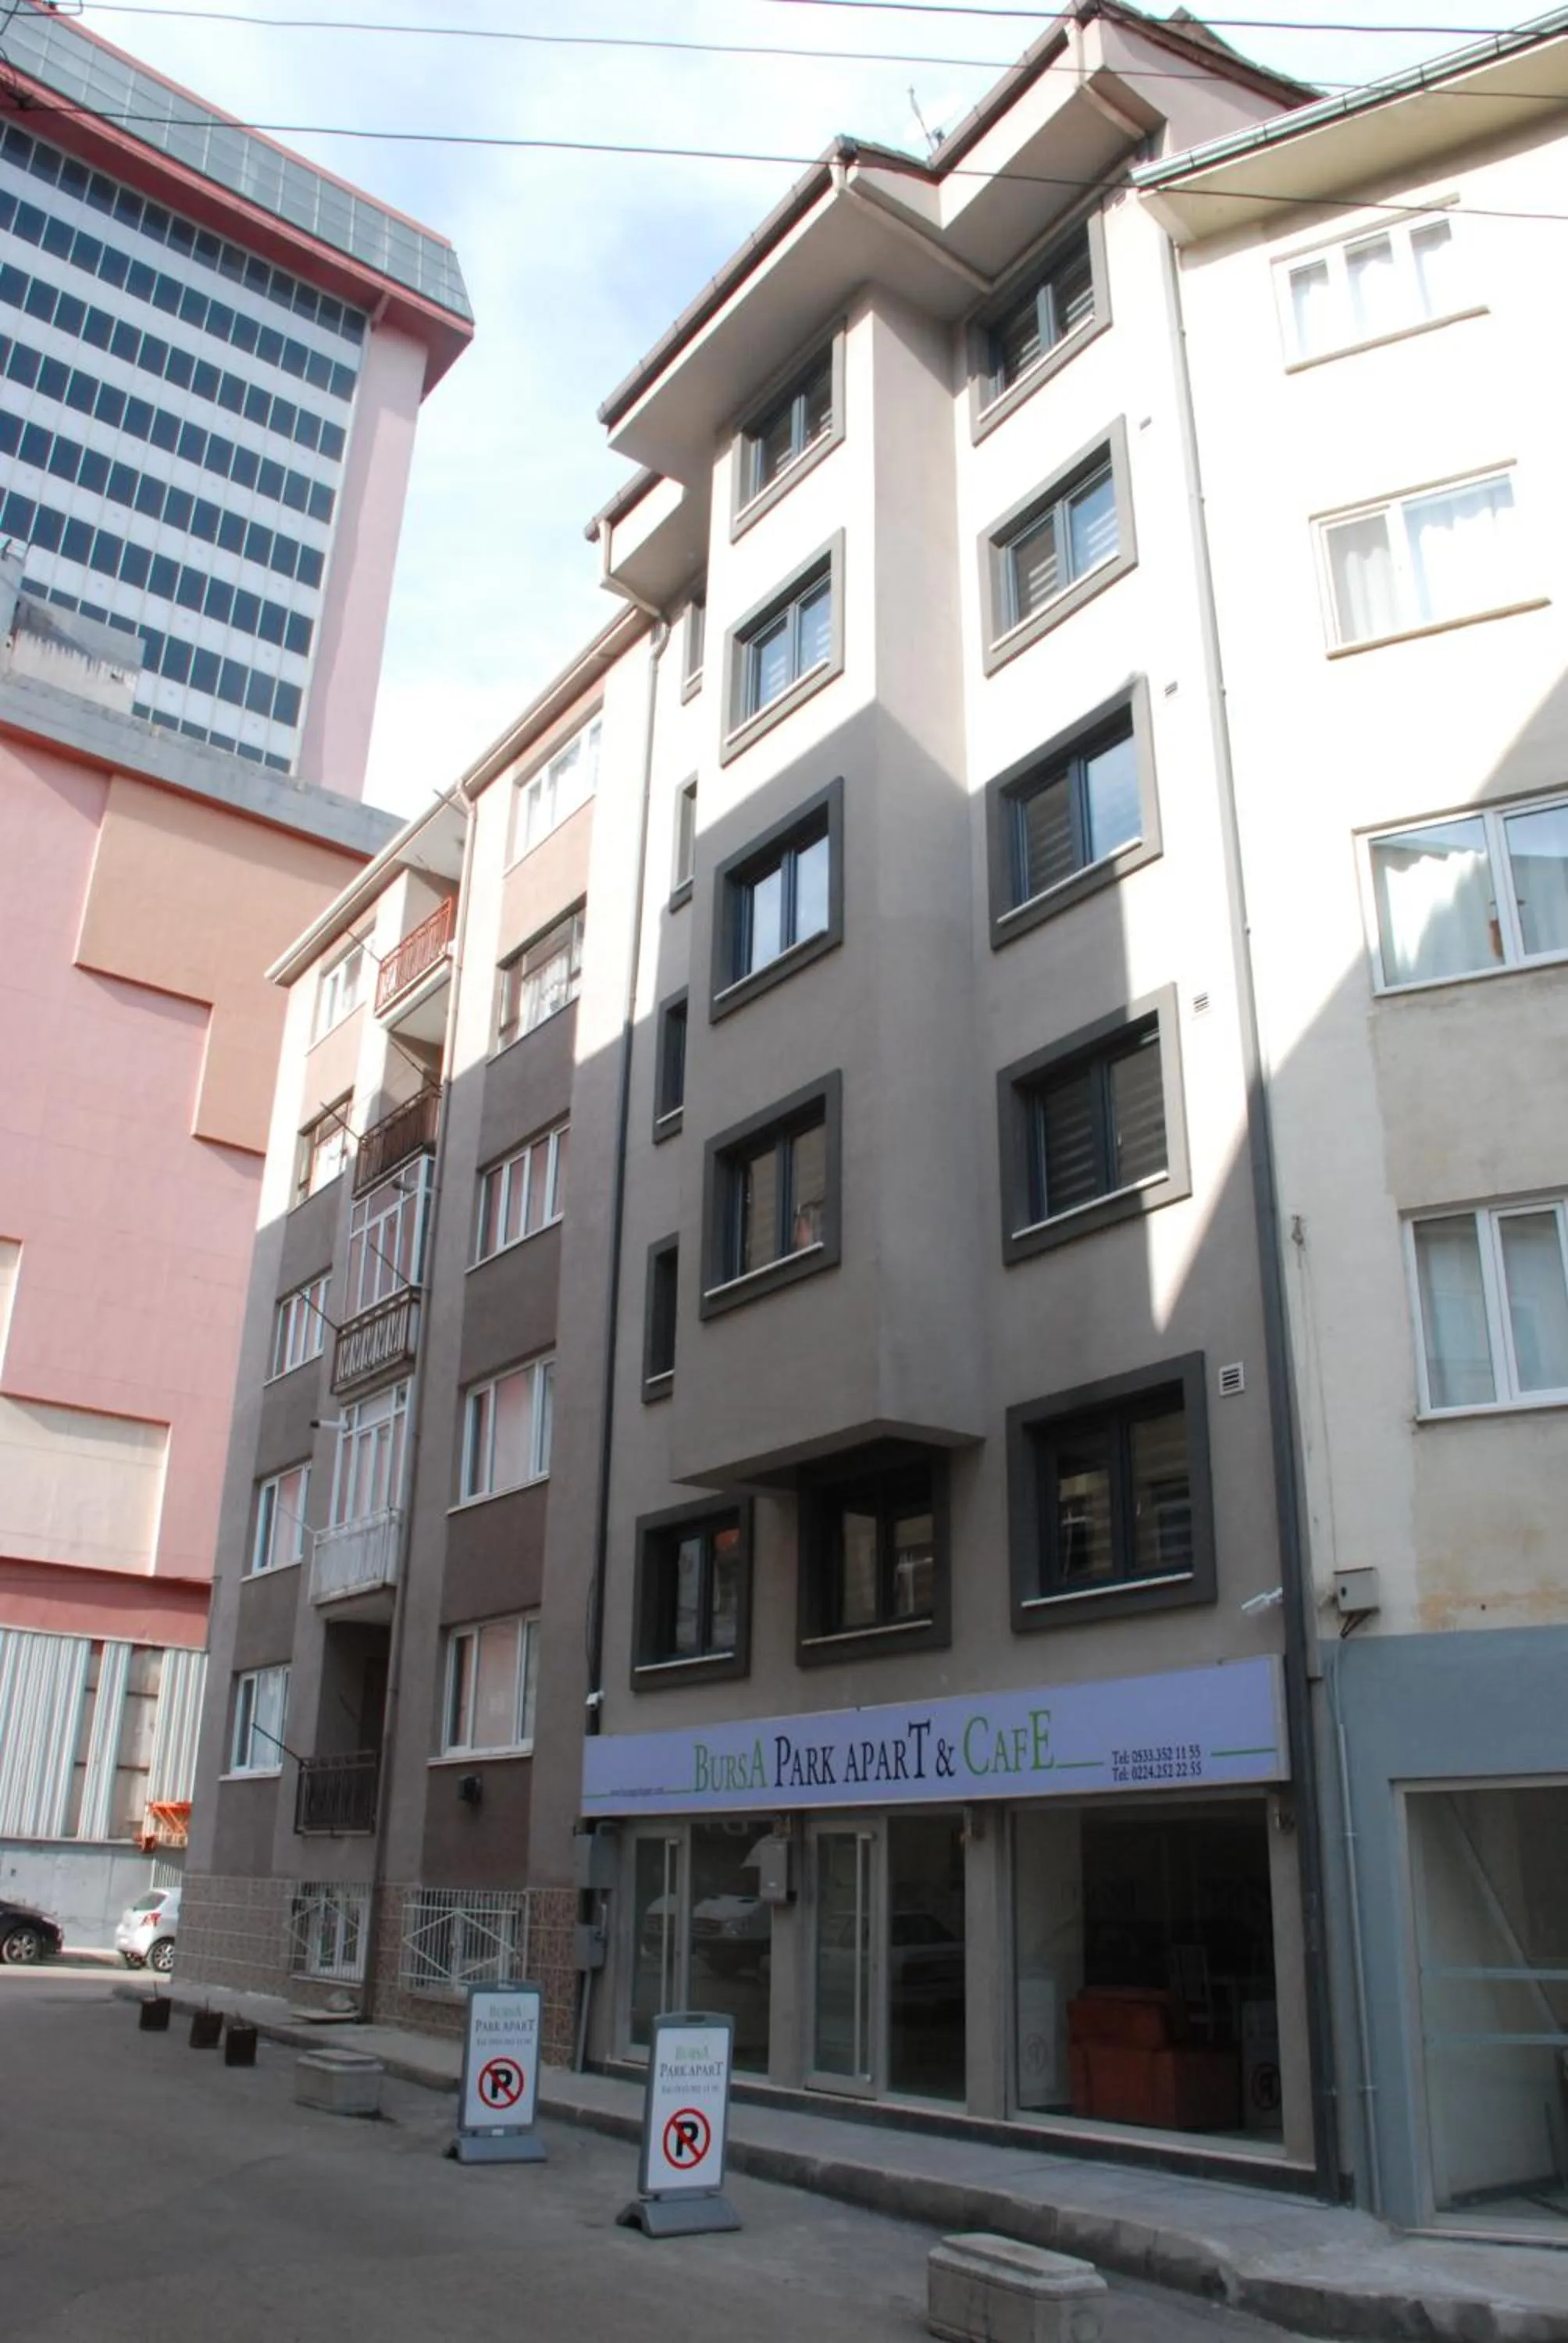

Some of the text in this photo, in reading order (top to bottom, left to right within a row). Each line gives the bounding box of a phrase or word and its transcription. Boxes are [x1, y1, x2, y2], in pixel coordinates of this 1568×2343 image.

[693, 1710, 1054, 1792] BURSA PARK APART & CAFE
[1111, 1750, 1129, 1765] Tel:
[1111, 1767, 1129, 1781] Tel:
[689, 2061, 724, 2076] APART
